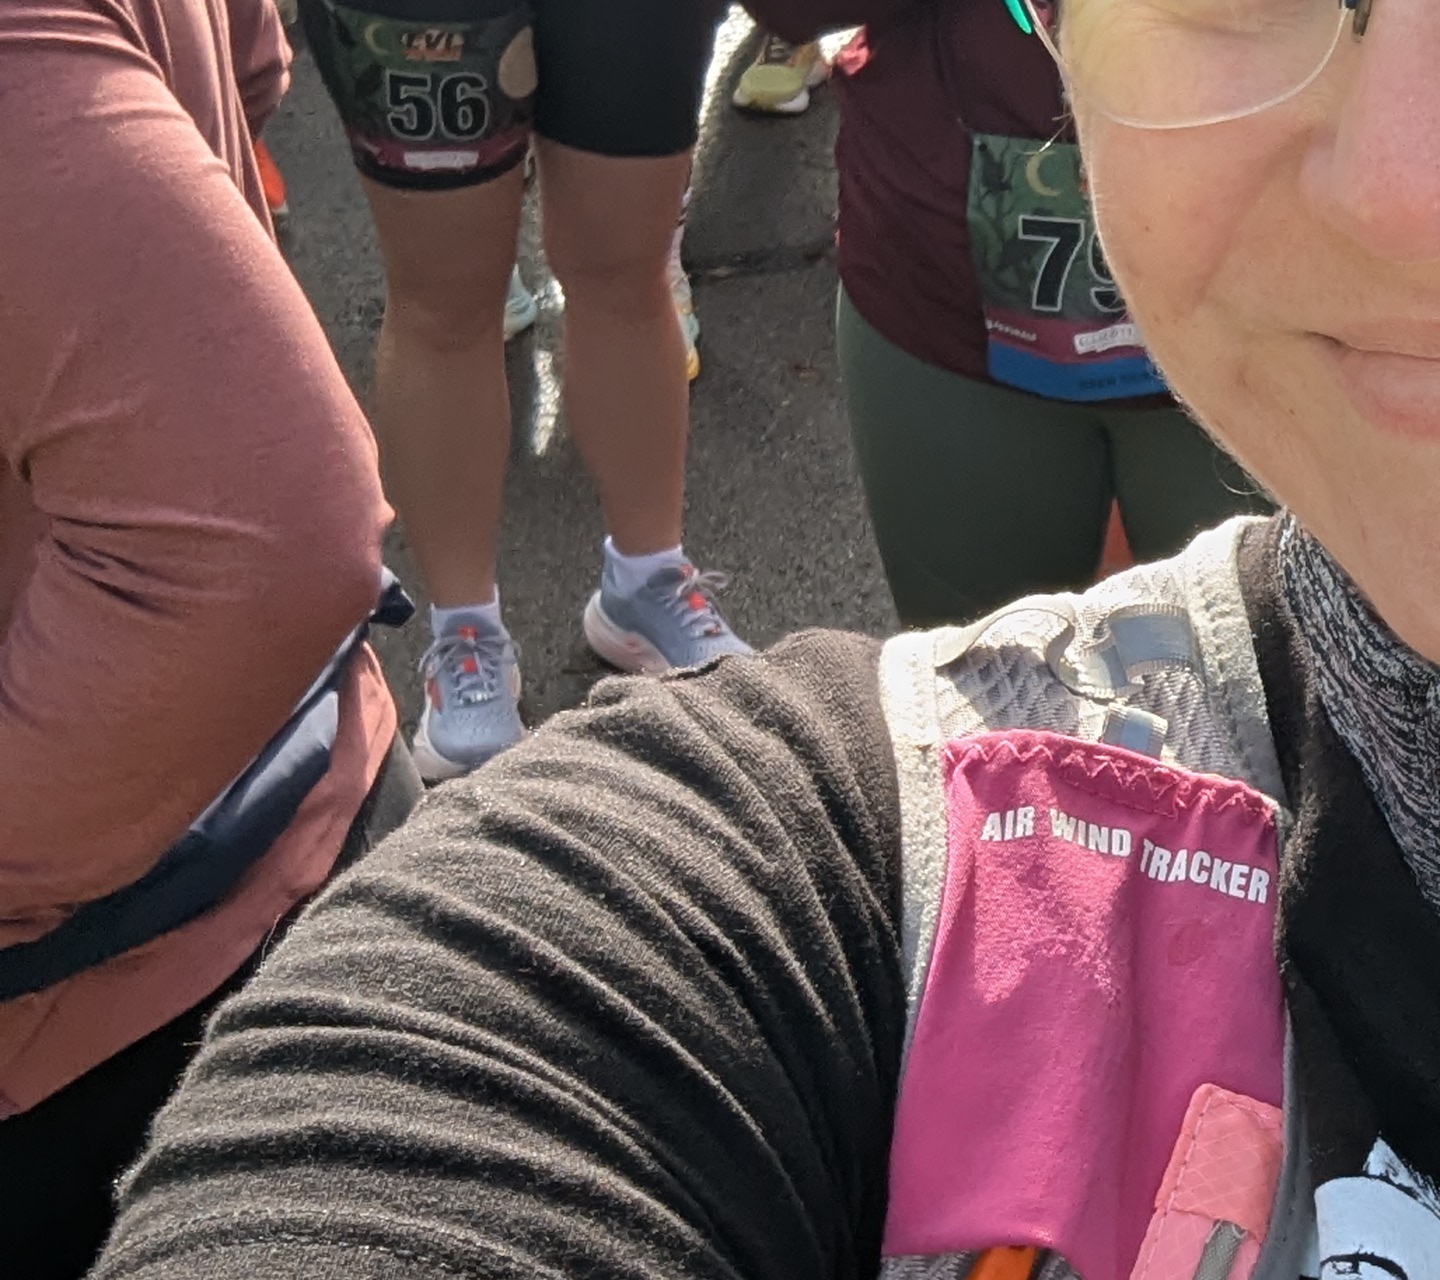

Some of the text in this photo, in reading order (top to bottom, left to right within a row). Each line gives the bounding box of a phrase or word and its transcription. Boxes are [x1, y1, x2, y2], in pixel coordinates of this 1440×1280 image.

[386, 69, 488, 142] 56
[979, 805, 1271, 906] AIR WIND TRACKER
